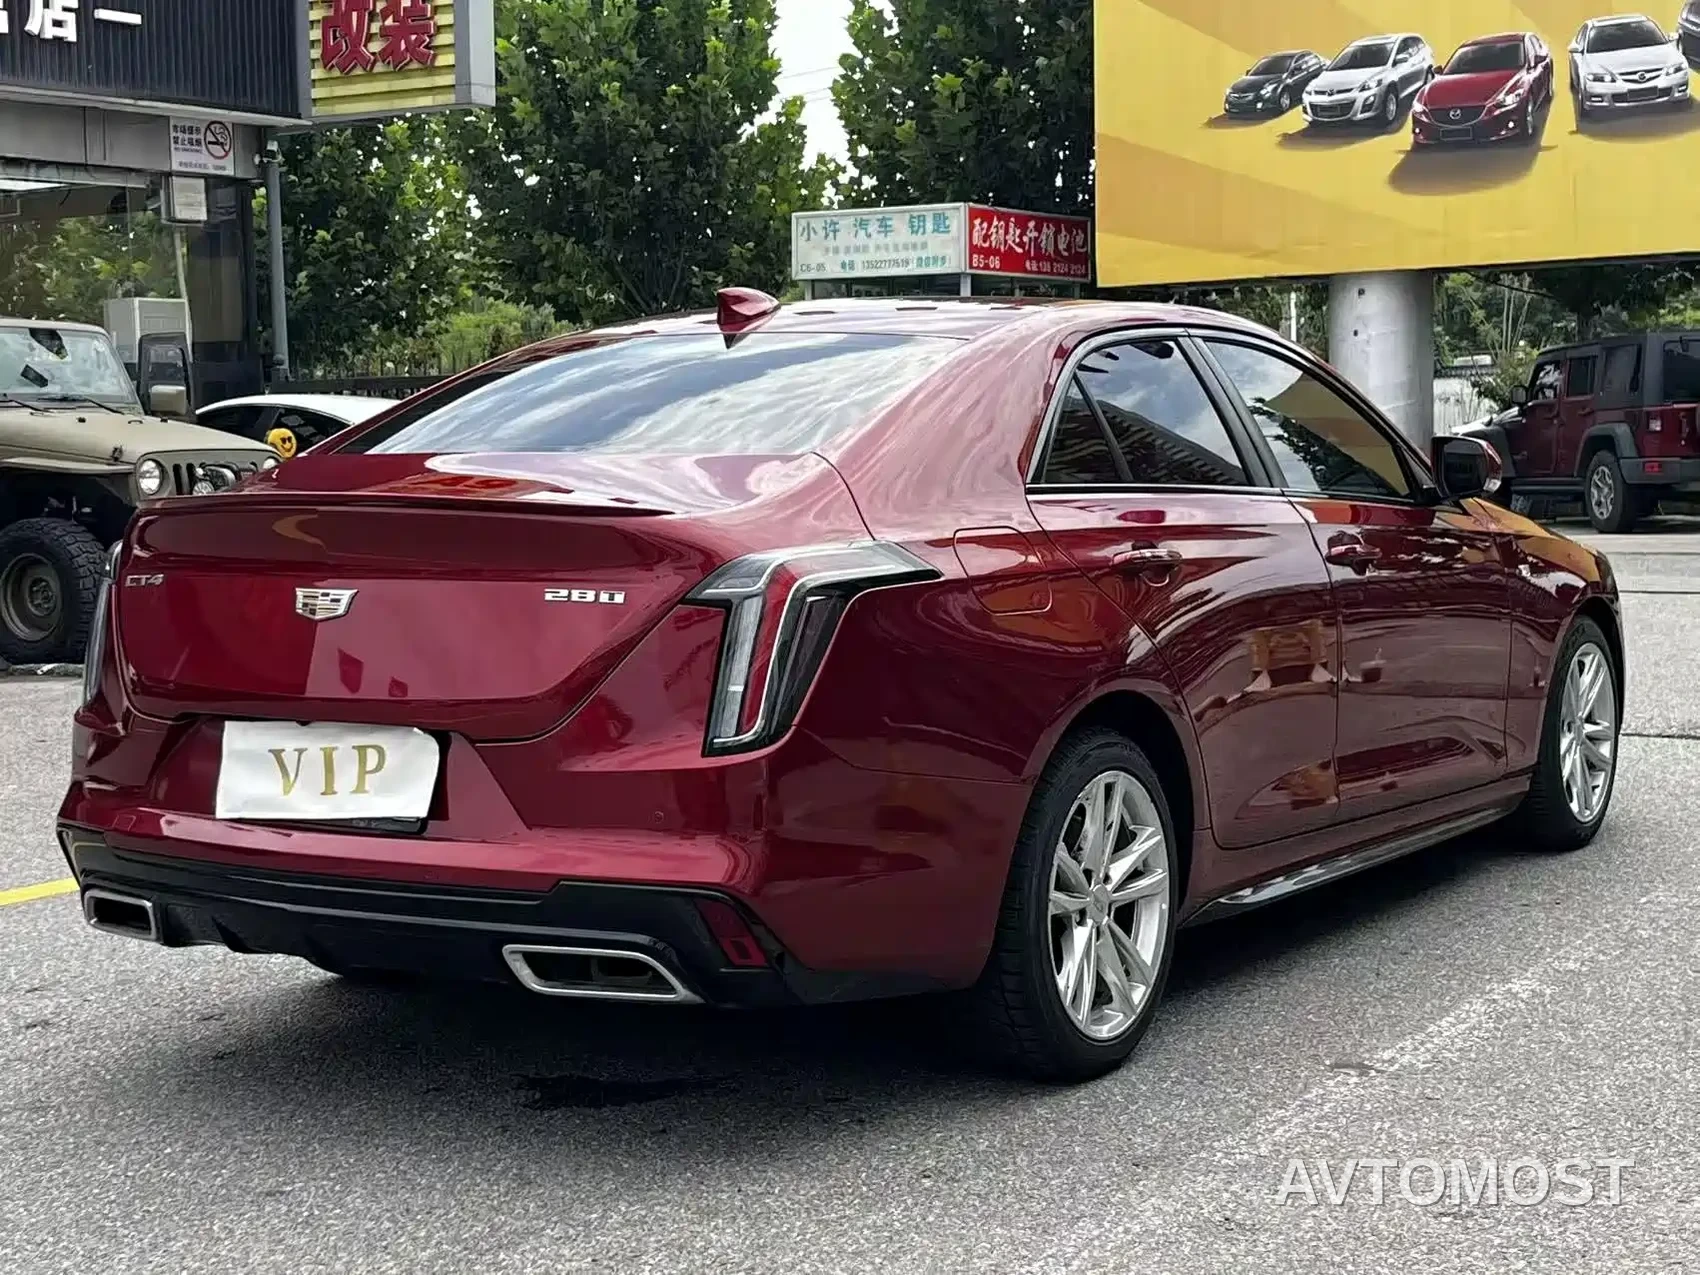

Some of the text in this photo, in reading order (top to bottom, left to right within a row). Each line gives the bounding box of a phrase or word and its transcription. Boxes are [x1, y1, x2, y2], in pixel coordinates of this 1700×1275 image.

[321, 0, 436, 75] 改装
[173, 135, 202, 147] 禁止吸烟
[800, 212, 951, 242] 小许 汽车 钥匙
[972, 254, 1000, 269] B5-06
[125, 573, 165, 588] CT4
[544, 588, 626, 604] 28T
[267, 744, 386, 796] VIP
